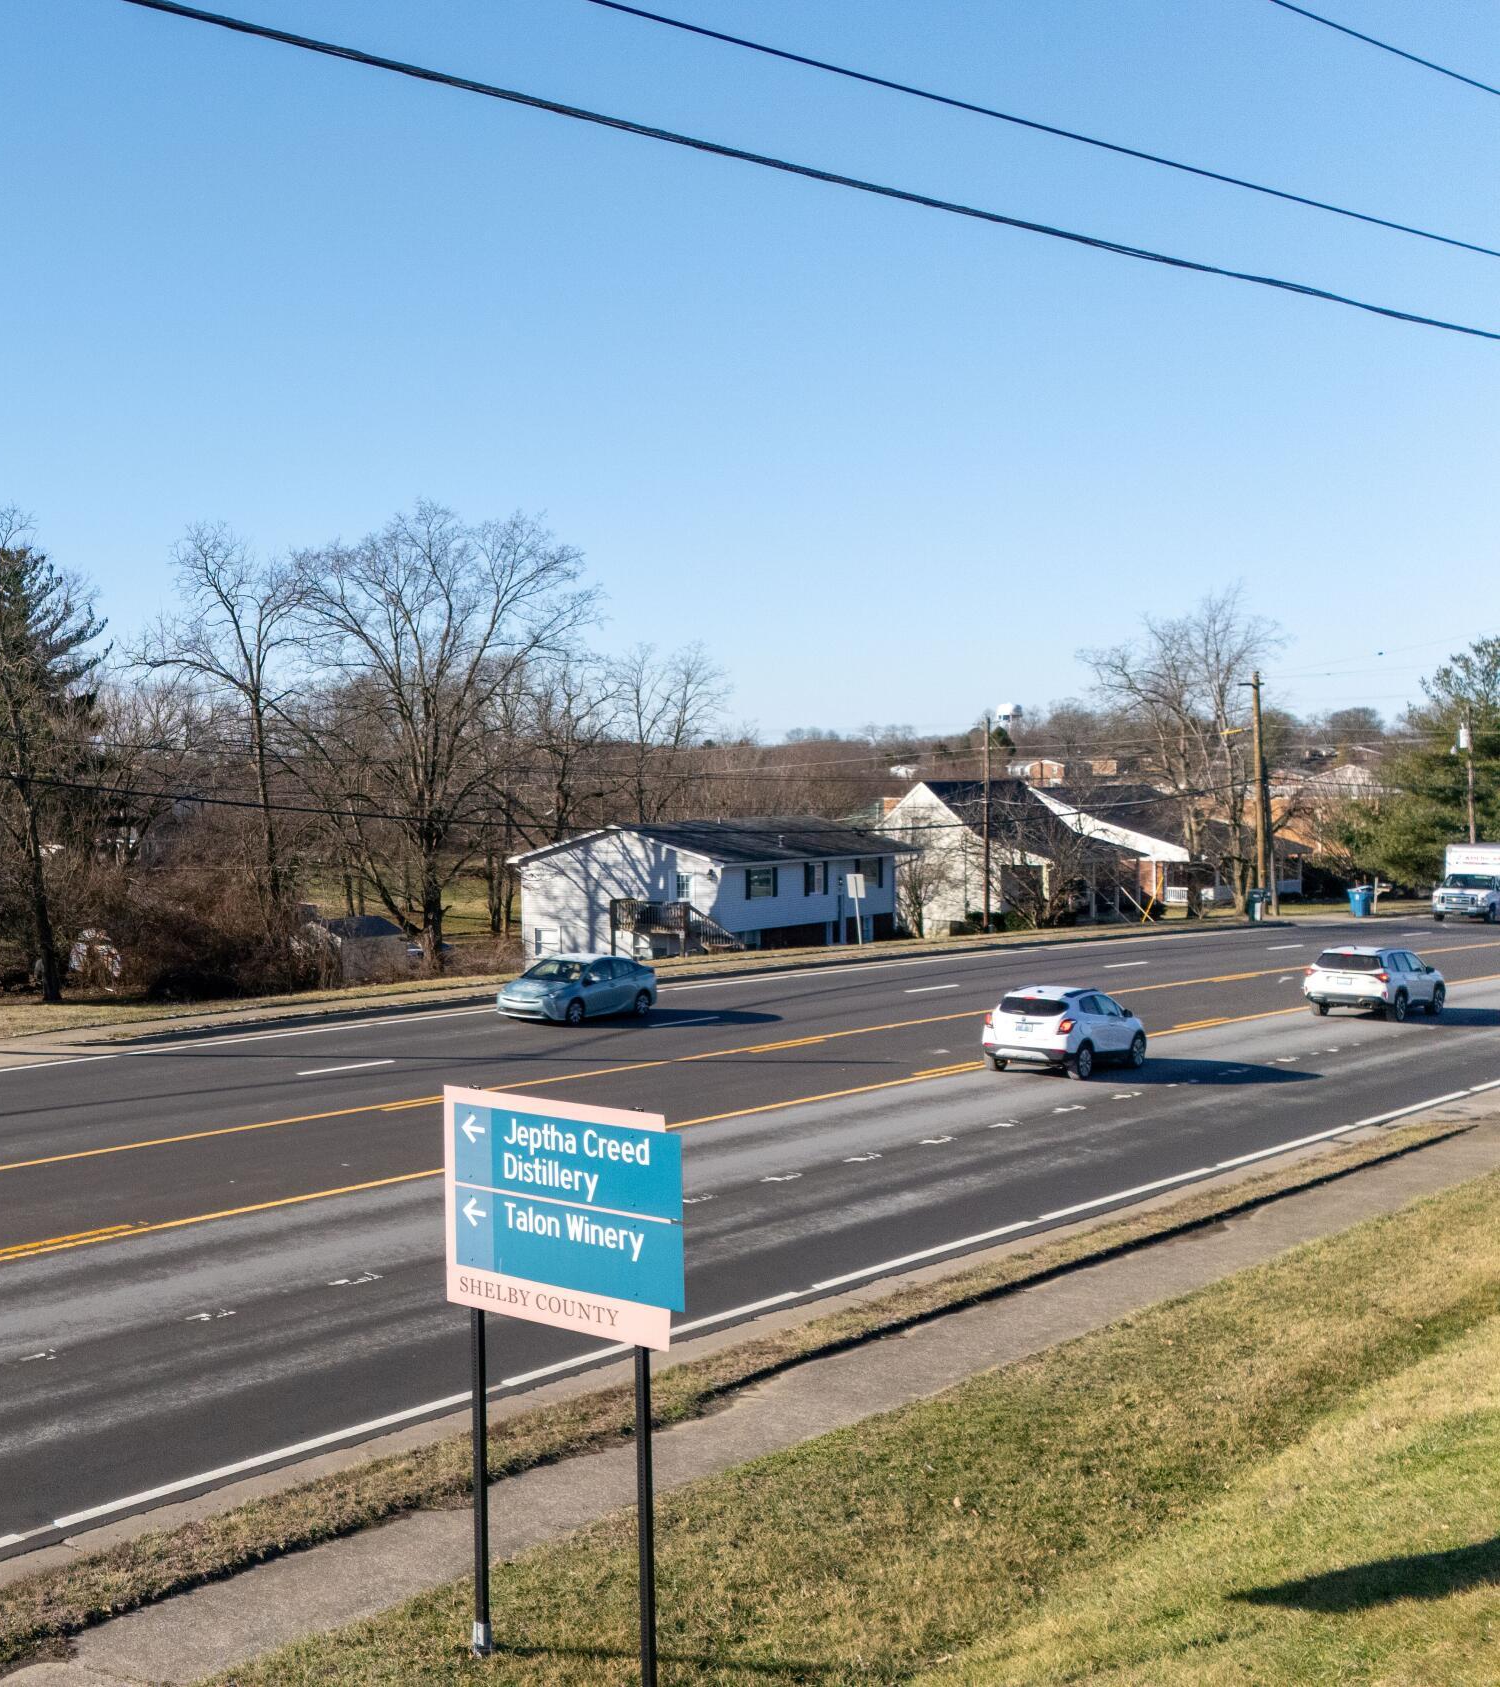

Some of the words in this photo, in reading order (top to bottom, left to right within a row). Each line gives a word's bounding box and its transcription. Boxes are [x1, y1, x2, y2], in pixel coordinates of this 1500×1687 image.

[504, 1118, 576, 1156] Jeptha
[583, 1129, 650, 1166] Creed
[504, 1153, 599, 1202] Distillery
[504, 1202, 560, 1238] Talon
[566, 1214, 644, 1262] Winery
[459, 1276, 530, 1307] SHELBY
[535, 1294, 619, 1327] COUNTY
